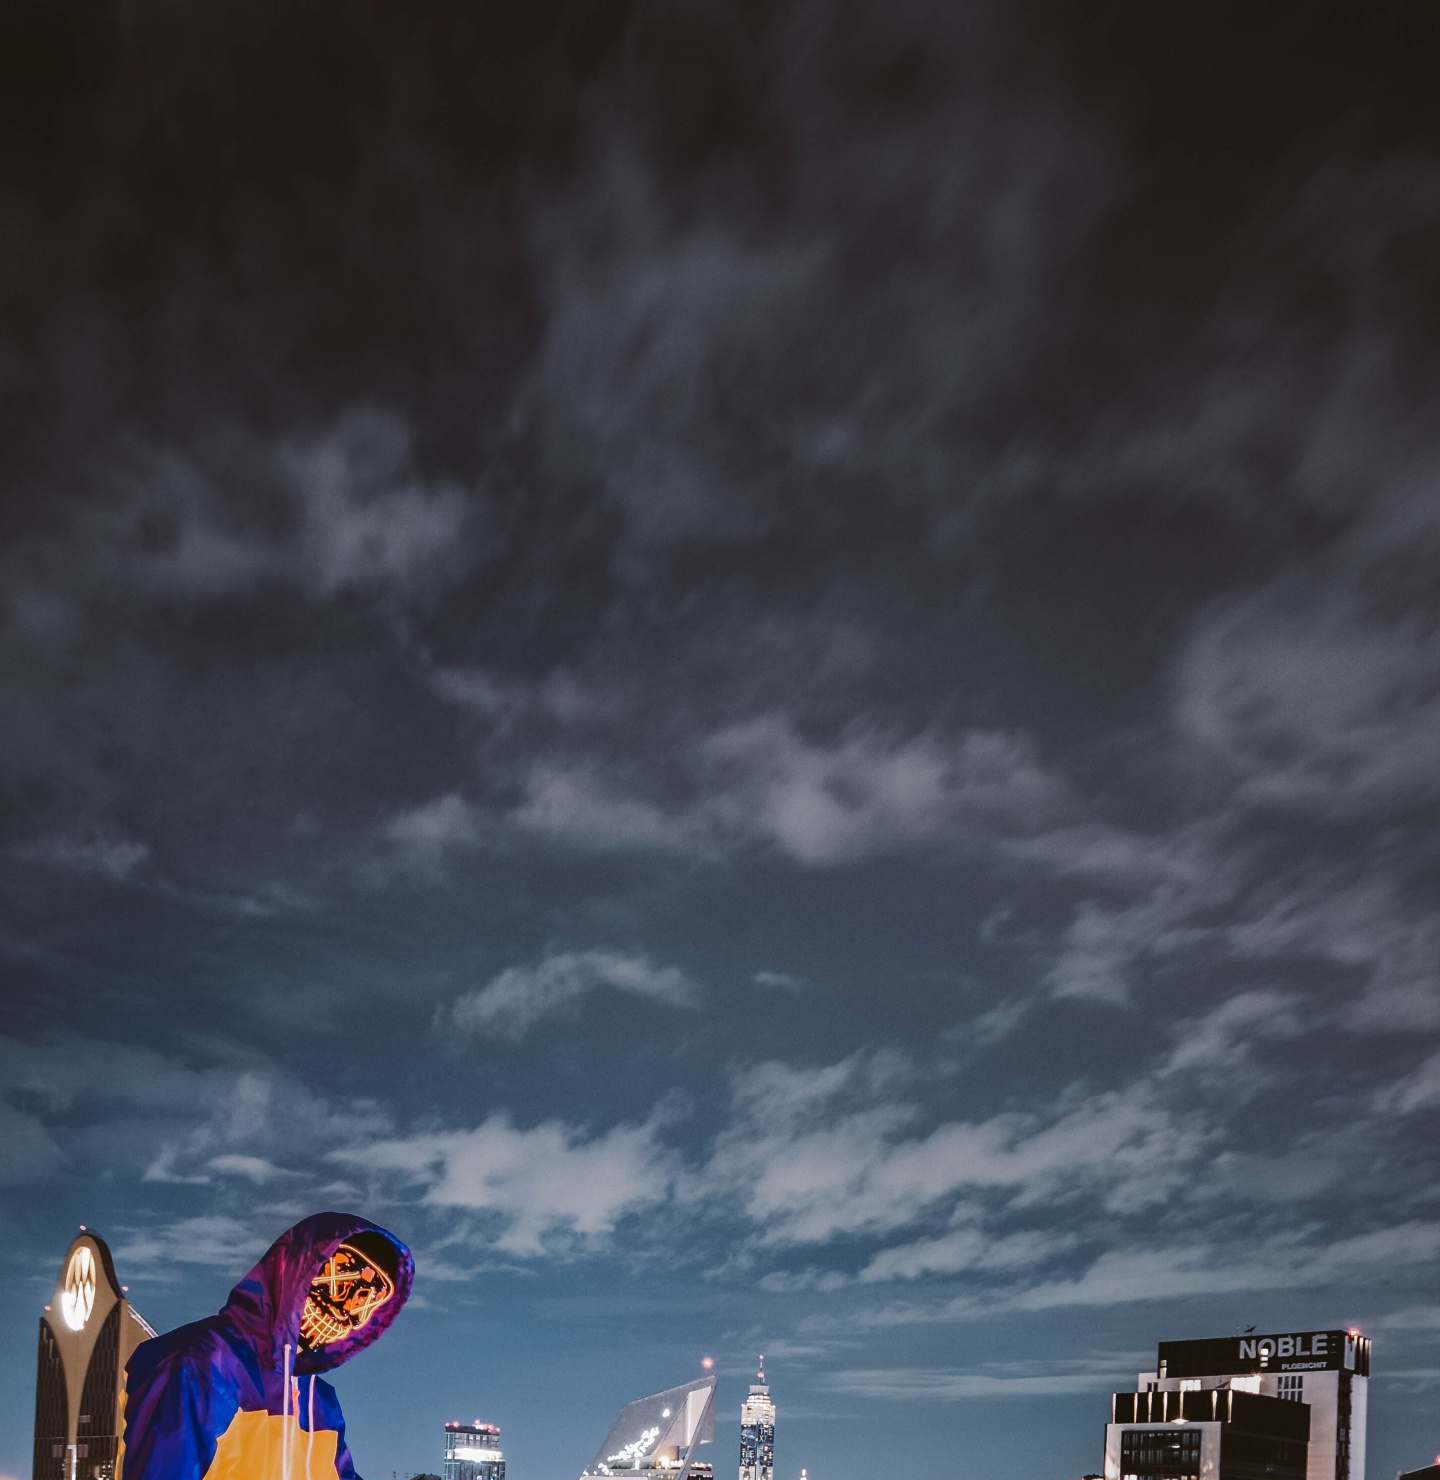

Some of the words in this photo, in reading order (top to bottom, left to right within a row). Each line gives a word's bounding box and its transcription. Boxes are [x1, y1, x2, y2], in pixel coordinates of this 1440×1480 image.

[1239, 1334, 1328, 1359] NOBLE
[1282, 1362, 1327, 1370] PLOENCHIT
[760, 1428, 773, 1436] THE
